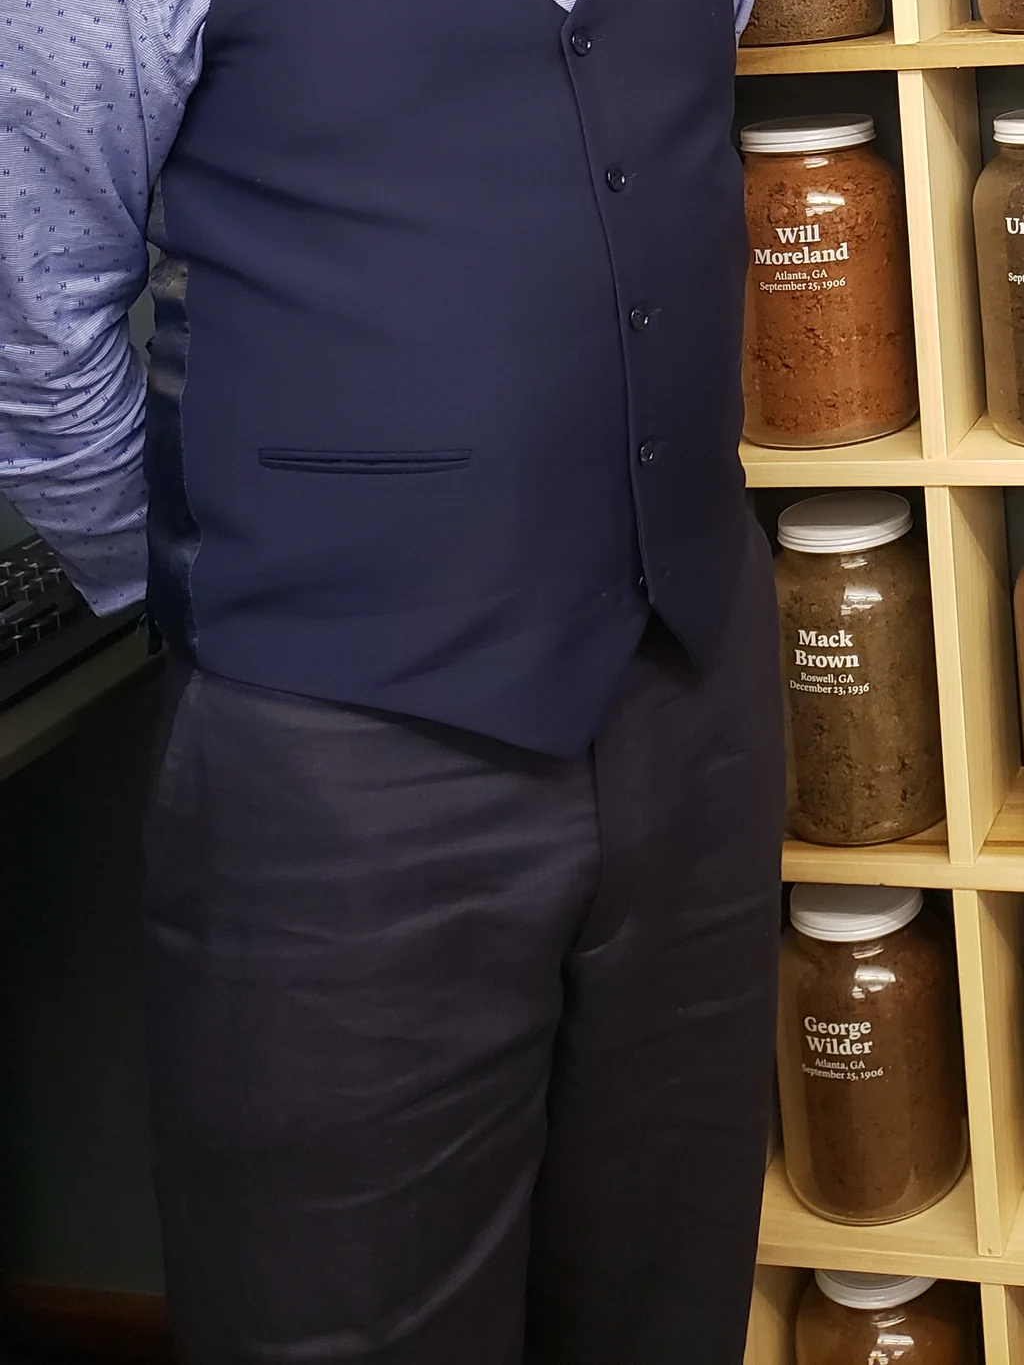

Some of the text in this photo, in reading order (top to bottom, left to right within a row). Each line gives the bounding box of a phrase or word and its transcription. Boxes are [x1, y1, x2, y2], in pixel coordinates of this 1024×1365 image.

[776, 224, 821, 243] Will
[754, 242, 849, 264] Moreland
[775, 269, 827, 280] Atlanta, GA
[760, 277, 845, 293] September 25, 1906
[798, 630, 853, 647] Mack
[795, 650, 859, 668] Brown
[801, 672, 854, 685] Roswell, GA
[790, 680, 869, 695] December 23, 1936
[805, 1017, 871, 1042] George
[807, 1036, 872, 1055] Wilder
[815, 1058, 865, 1070] Atlanta, GA
[847, 1070, 858, 1081] 25,
[860, 1068, 883, 1080] 1906
